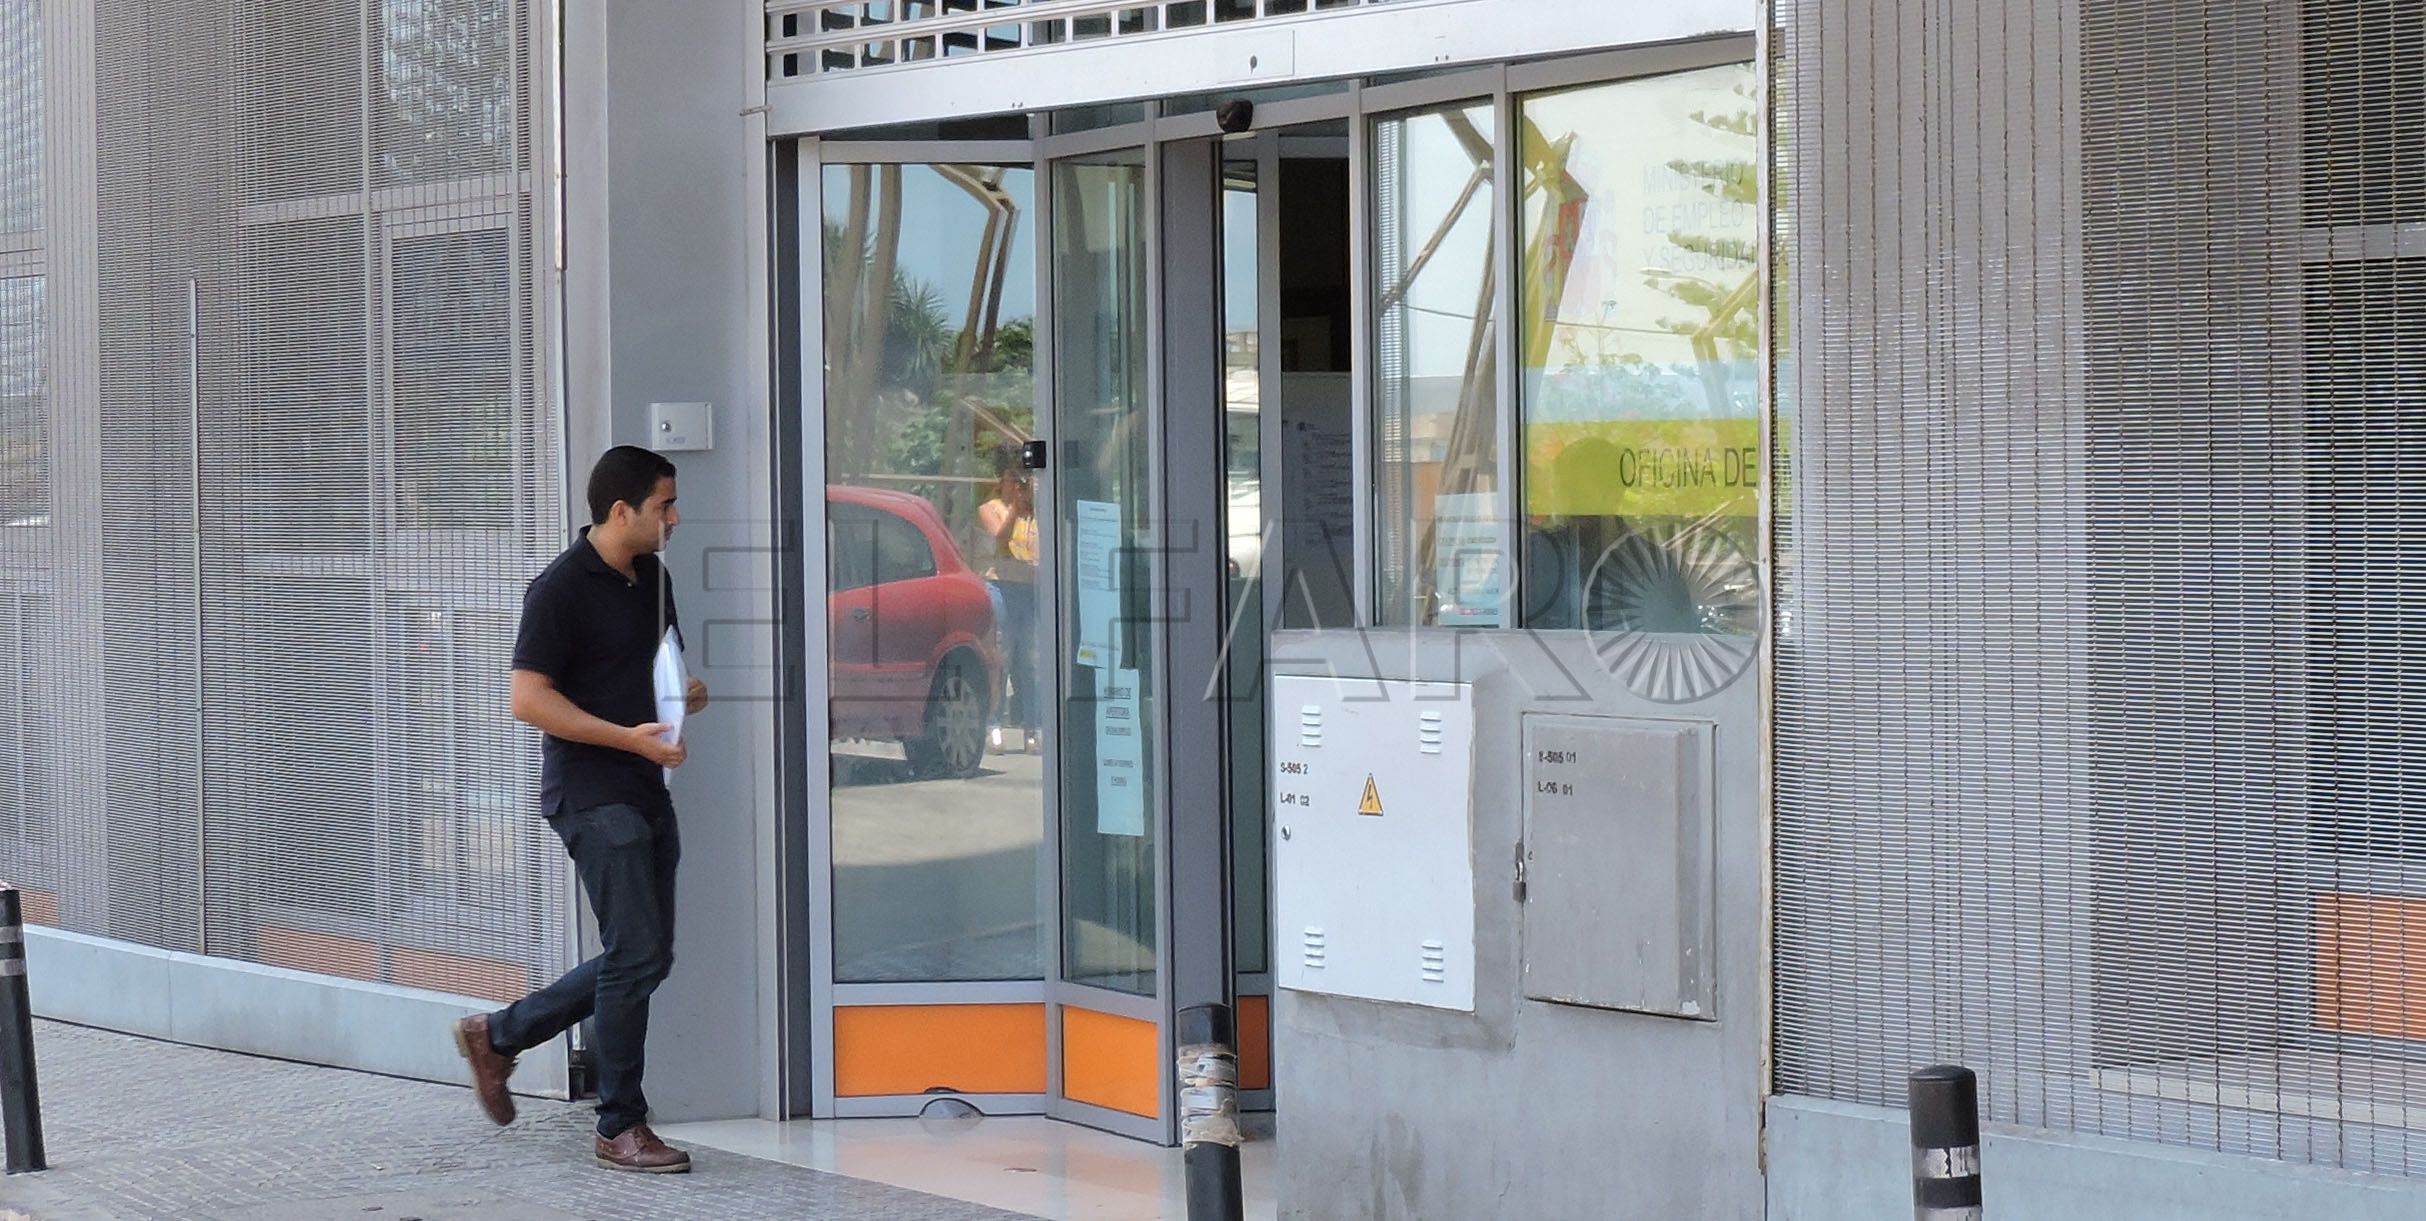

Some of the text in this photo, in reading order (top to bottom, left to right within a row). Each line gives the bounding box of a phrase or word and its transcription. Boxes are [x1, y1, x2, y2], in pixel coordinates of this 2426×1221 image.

[1643, 200, 1744, 234] DE EMPLEO
[1618, 447, 1716, 487] OFICINA
[1723, 447, 1757, 487] DE
[1566, 751, 1577, 764] 01
[1562, 783, 1573, 797] 01
[1280, 791, 1296, 804] L-01
